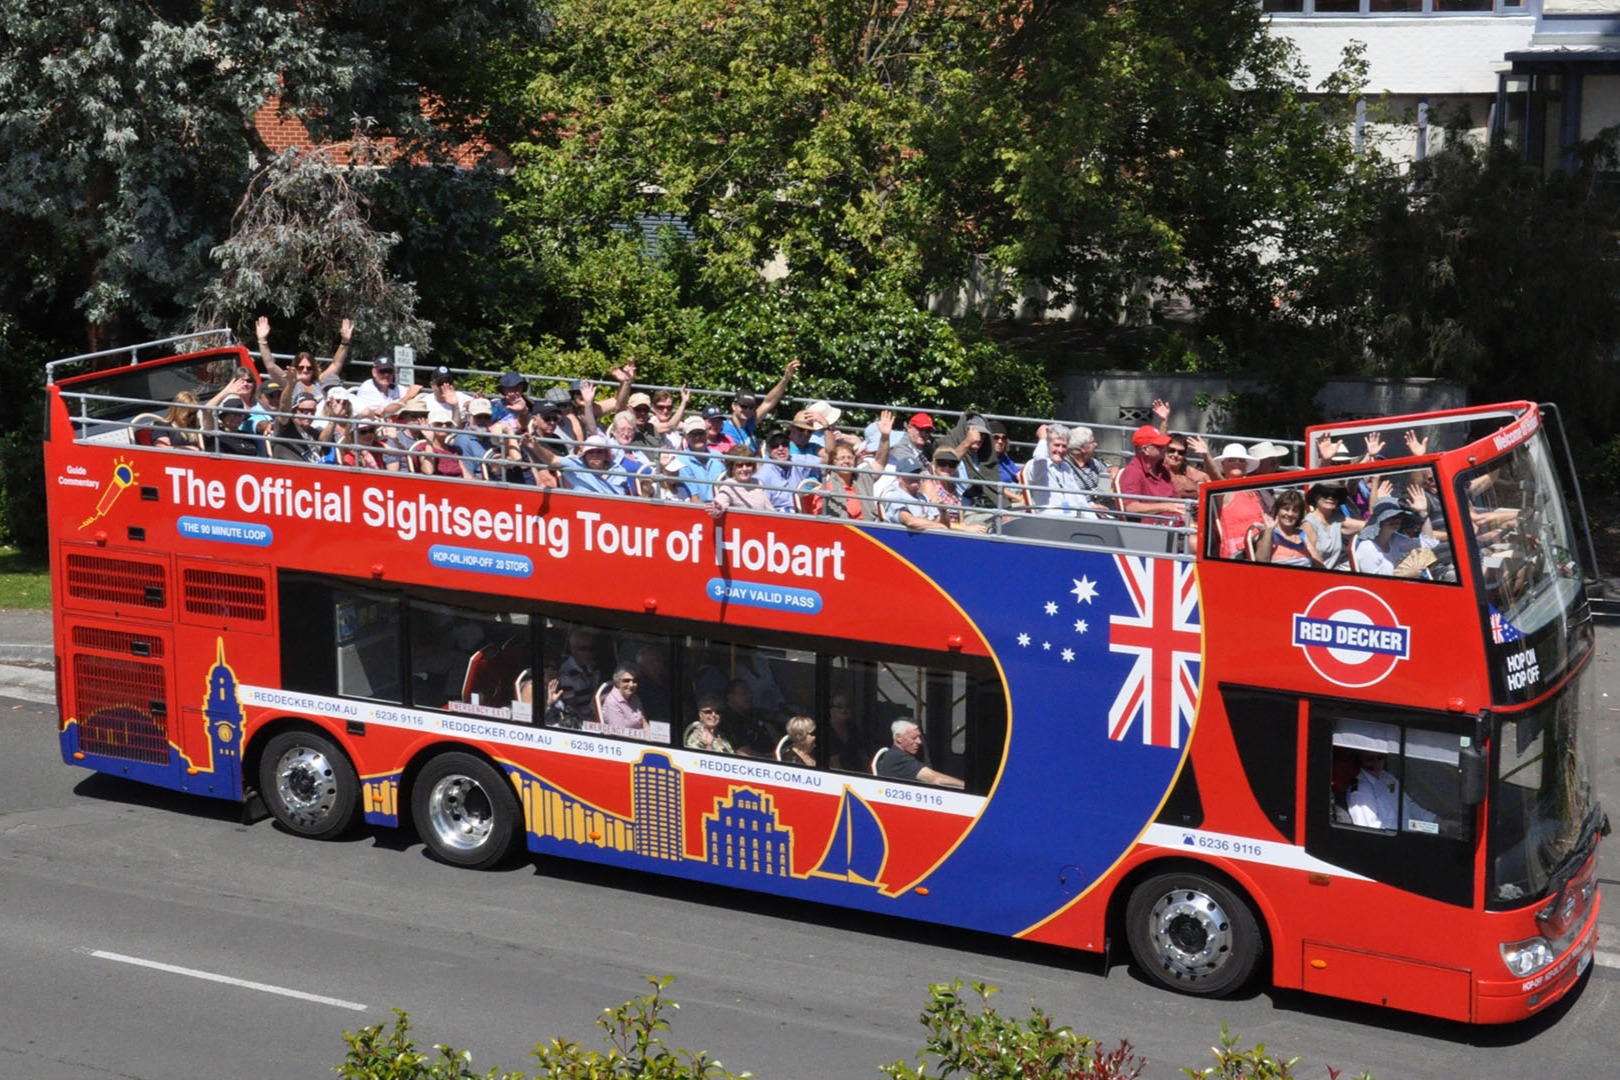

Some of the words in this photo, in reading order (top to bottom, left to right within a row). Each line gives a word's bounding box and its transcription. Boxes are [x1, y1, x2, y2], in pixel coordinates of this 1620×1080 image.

[66, 465, 87, 475] Guide
[58, 475, 99, 490] Commentary
[165, 466, 226, 509] The
[236, 474, 351, 524] Official
[362, 487, 569, 558] Sightseeing
[576, 510, 659, 558] Tour
[666, 523, 703, 564] of
[715, 526, 845, 581] Hobart
[183, 522, 200, 533] THE
[201, 525, 211, 535] 90
[211, 525, 242, 538] MINUTE
[243, 529, 267, 541] LOOP
[495, 559, 504, 570] 20
[505, 560, 529, 573] STOPS
[714, 585, 747, 600] 3-DAY
[749, 589, 782, 604] VALID
[785, 593, 815, 608] PASS
[1300, 621, 1332, 643] RED
[1336, 626, 1403, 651] DECKER
[1507, 652, 1525, 672] HOP
[1525, 648, 1536, 666] ON
[1507, 671, 1526, 690] HOP
[1527, 665, 1540, 684] OFF
[254, 691, 358, 716] REDDECKER.COM.AU
[375, 711, 398, 723] 6236
[400, 714, 424, 726] 9116
[441, 719, 552, 745] REDDECKER.COM.AU
[570, 739, 595, 753] 6236
[597, 743, 622, 756] 9116
[700, 759, 822, 787] REDDECKER.COM.AU
[885, 787, 912, 801] 6236
[915, 792, 943, 806] 9116
[1199, 837, 1229, 851] 6236
[1233, 841, 1262, 856] 9116
